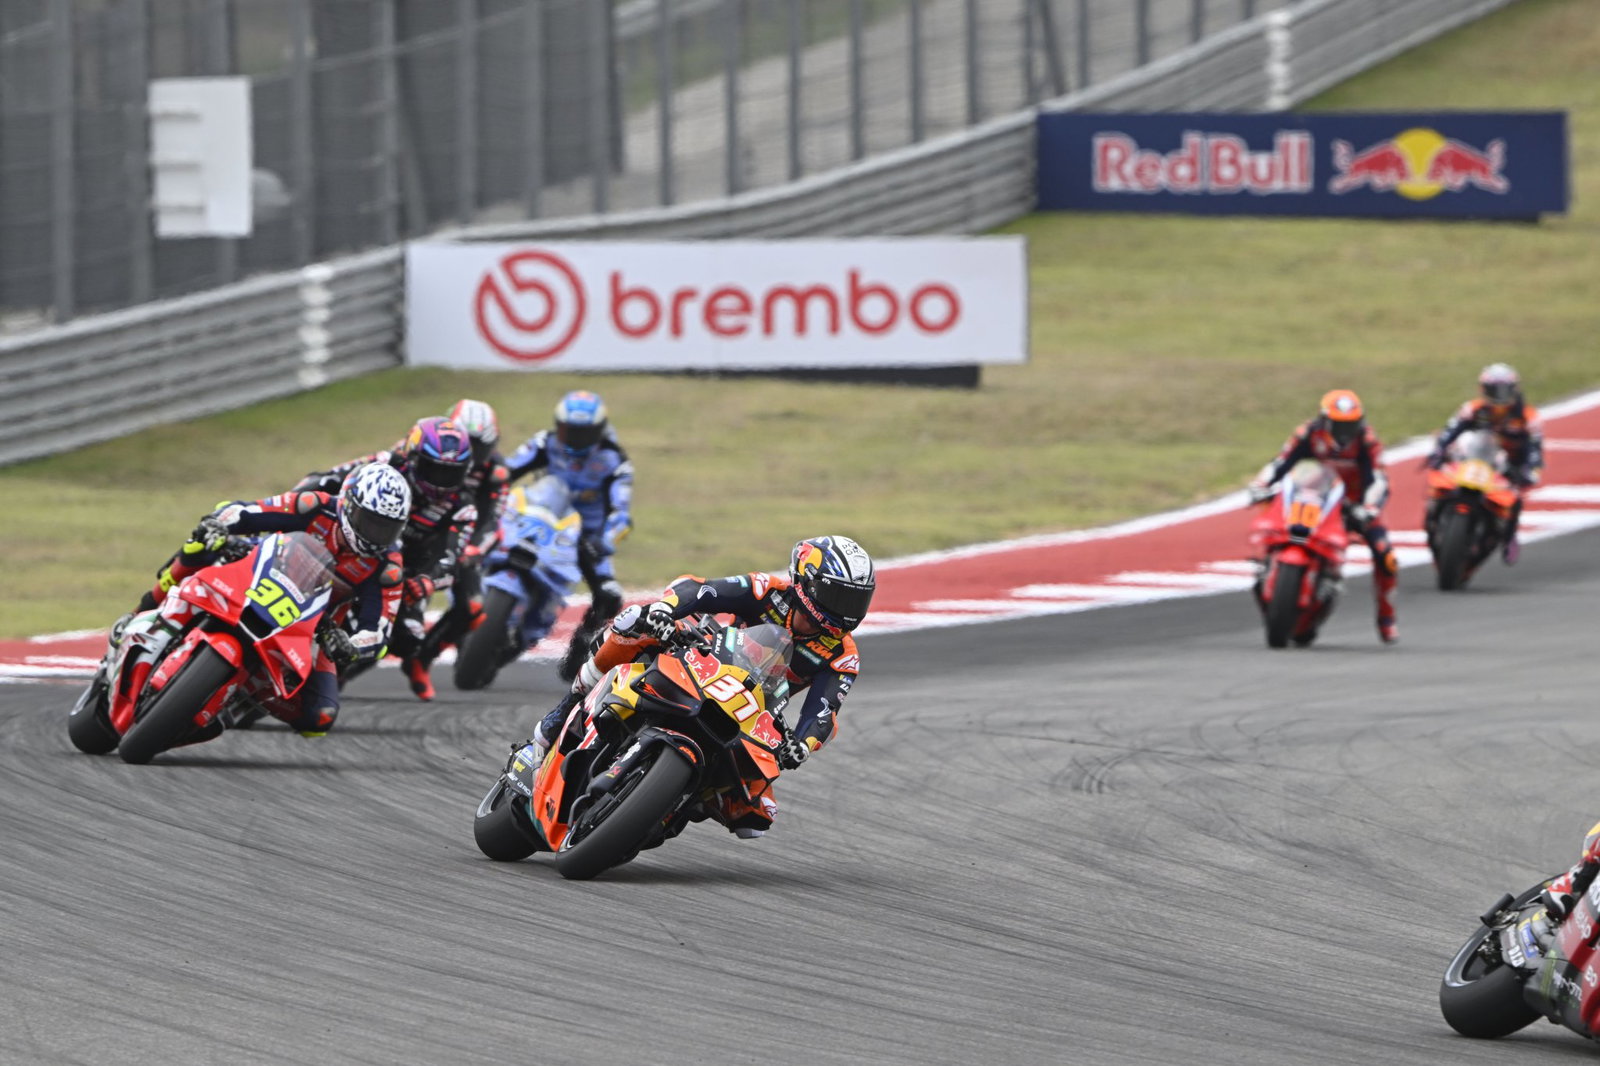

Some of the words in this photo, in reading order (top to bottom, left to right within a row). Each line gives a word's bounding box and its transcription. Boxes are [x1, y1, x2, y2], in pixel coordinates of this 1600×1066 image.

[1094, 132, 1199, 193] Red
[1209, 131, 1311, 193] Bull
[610, 269, 961, 338] brembo
[245, 578, 301, 628] 36
[805, 641, 834, 660] KTM
[703, 674, 760, 723] 37
